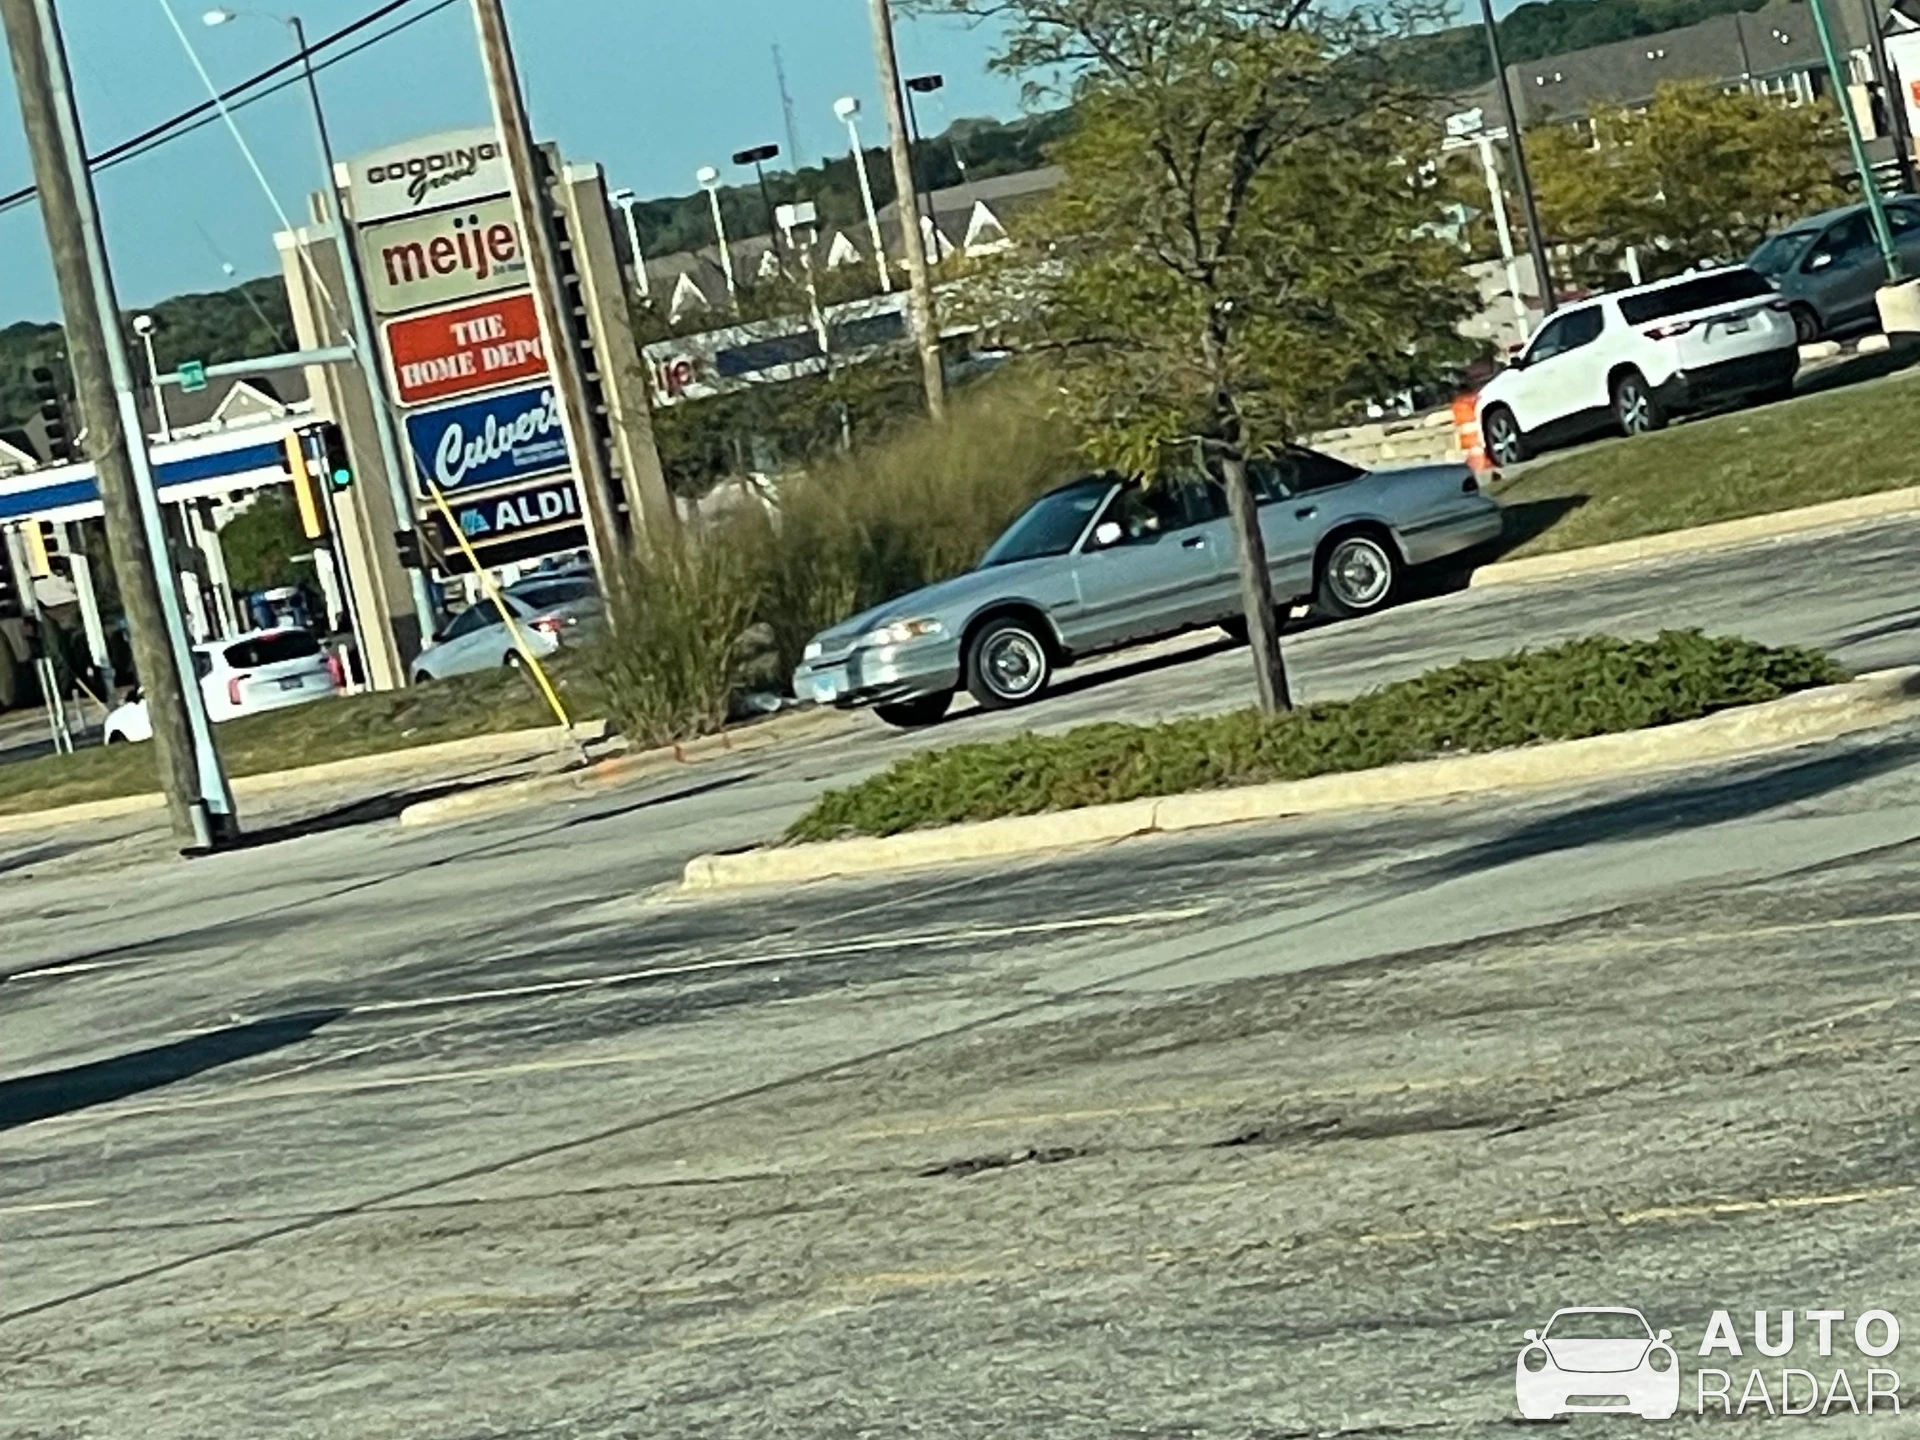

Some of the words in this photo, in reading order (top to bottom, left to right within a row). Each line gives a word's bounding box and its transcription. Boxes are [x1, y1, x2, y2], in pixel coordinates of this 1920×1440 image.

[382, 214, 524, 286] meije
[450, 314, 506, 347] THE
[400, 350, 477, 389] HOME
[495, 487, 576, 530] ALDI
